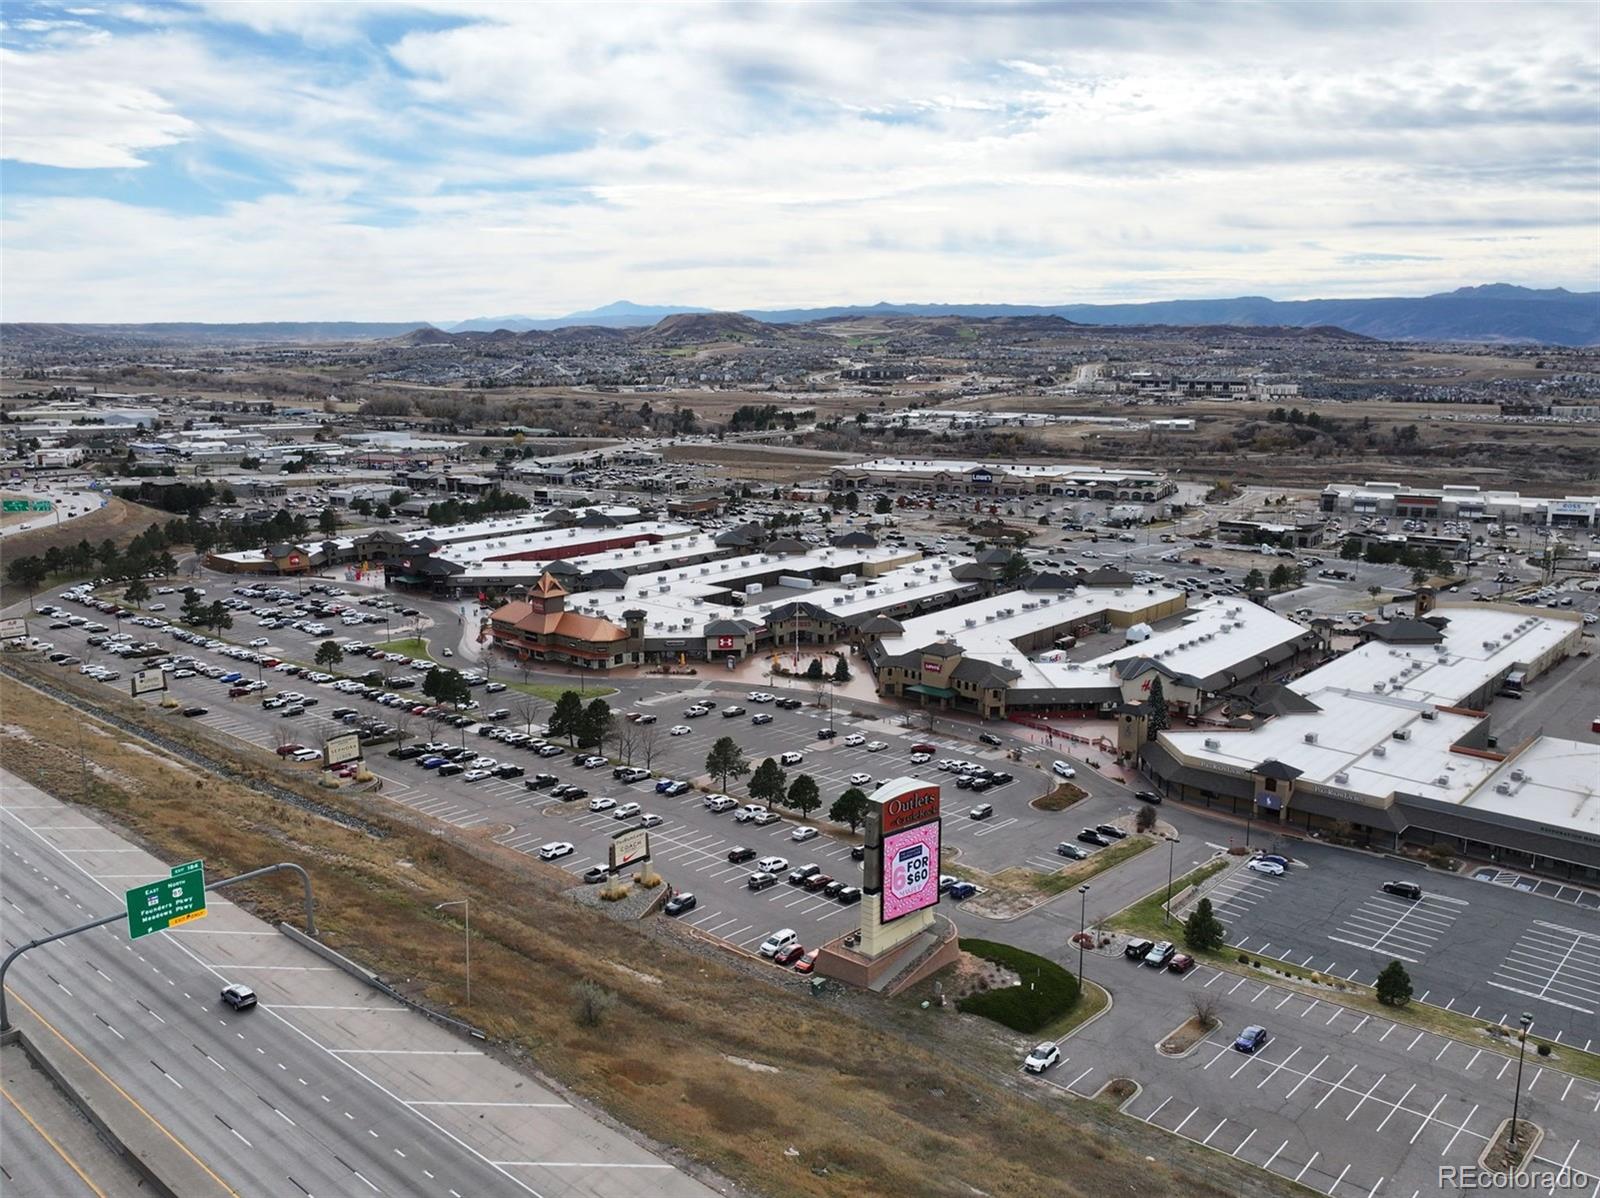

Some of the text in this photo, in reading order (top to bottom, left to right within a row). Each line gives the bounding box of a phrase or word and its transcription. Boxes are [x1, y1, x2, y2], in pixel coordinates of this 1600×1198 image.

[888, 793, 936, 815] Outlets
[893, 855, 928, 891] 6 FOR
[907, 868, 928, 886] $60
[140, 896, 193, 916] Founders Pkwy
[142, 903, 193, 923] Meadows Pkwy
